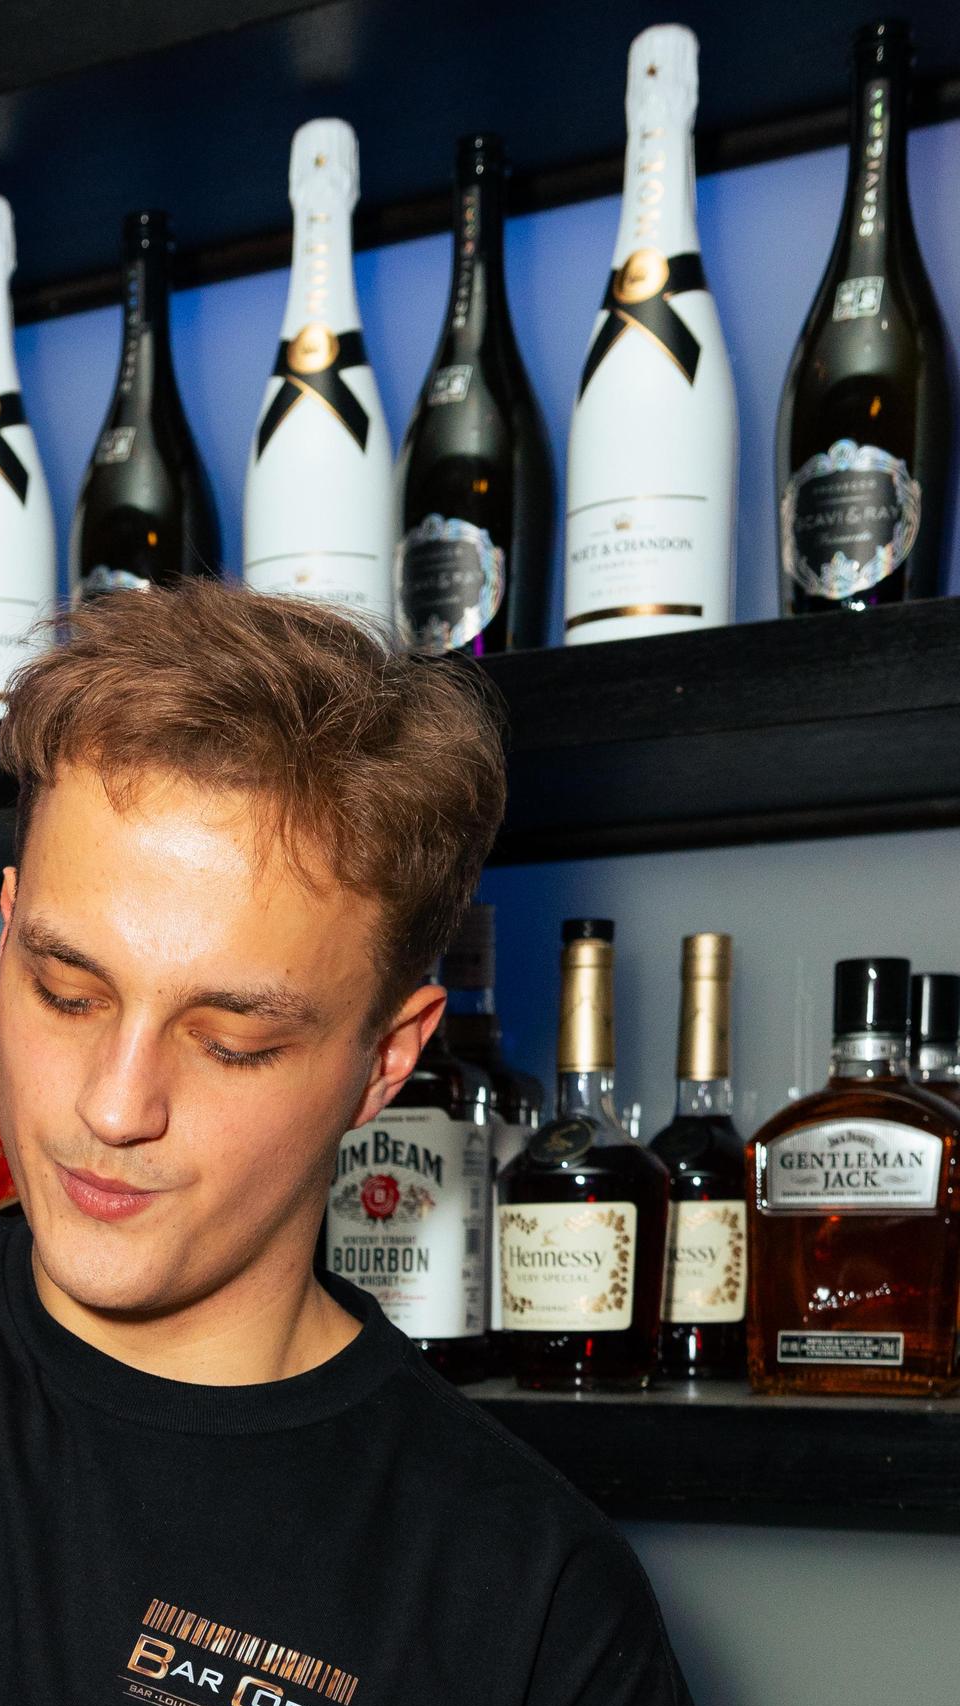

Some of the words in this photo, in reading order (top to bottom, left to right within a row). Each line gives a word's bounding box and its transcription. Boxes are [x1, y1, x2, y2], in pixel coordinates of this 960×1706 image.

[613, 536, 694, 554] CHANDON
[372, 1131, 444, 1188] BEAM
[779, 1151, 924, 1170] GENTLEMAN
[822, 1170, 881, 1191] JACK
[333, 1247, 430, 1273] BOURBON
[508, 1245, 606, 1273] Hennessy
[129, 1684, 153, 1698] BAR
